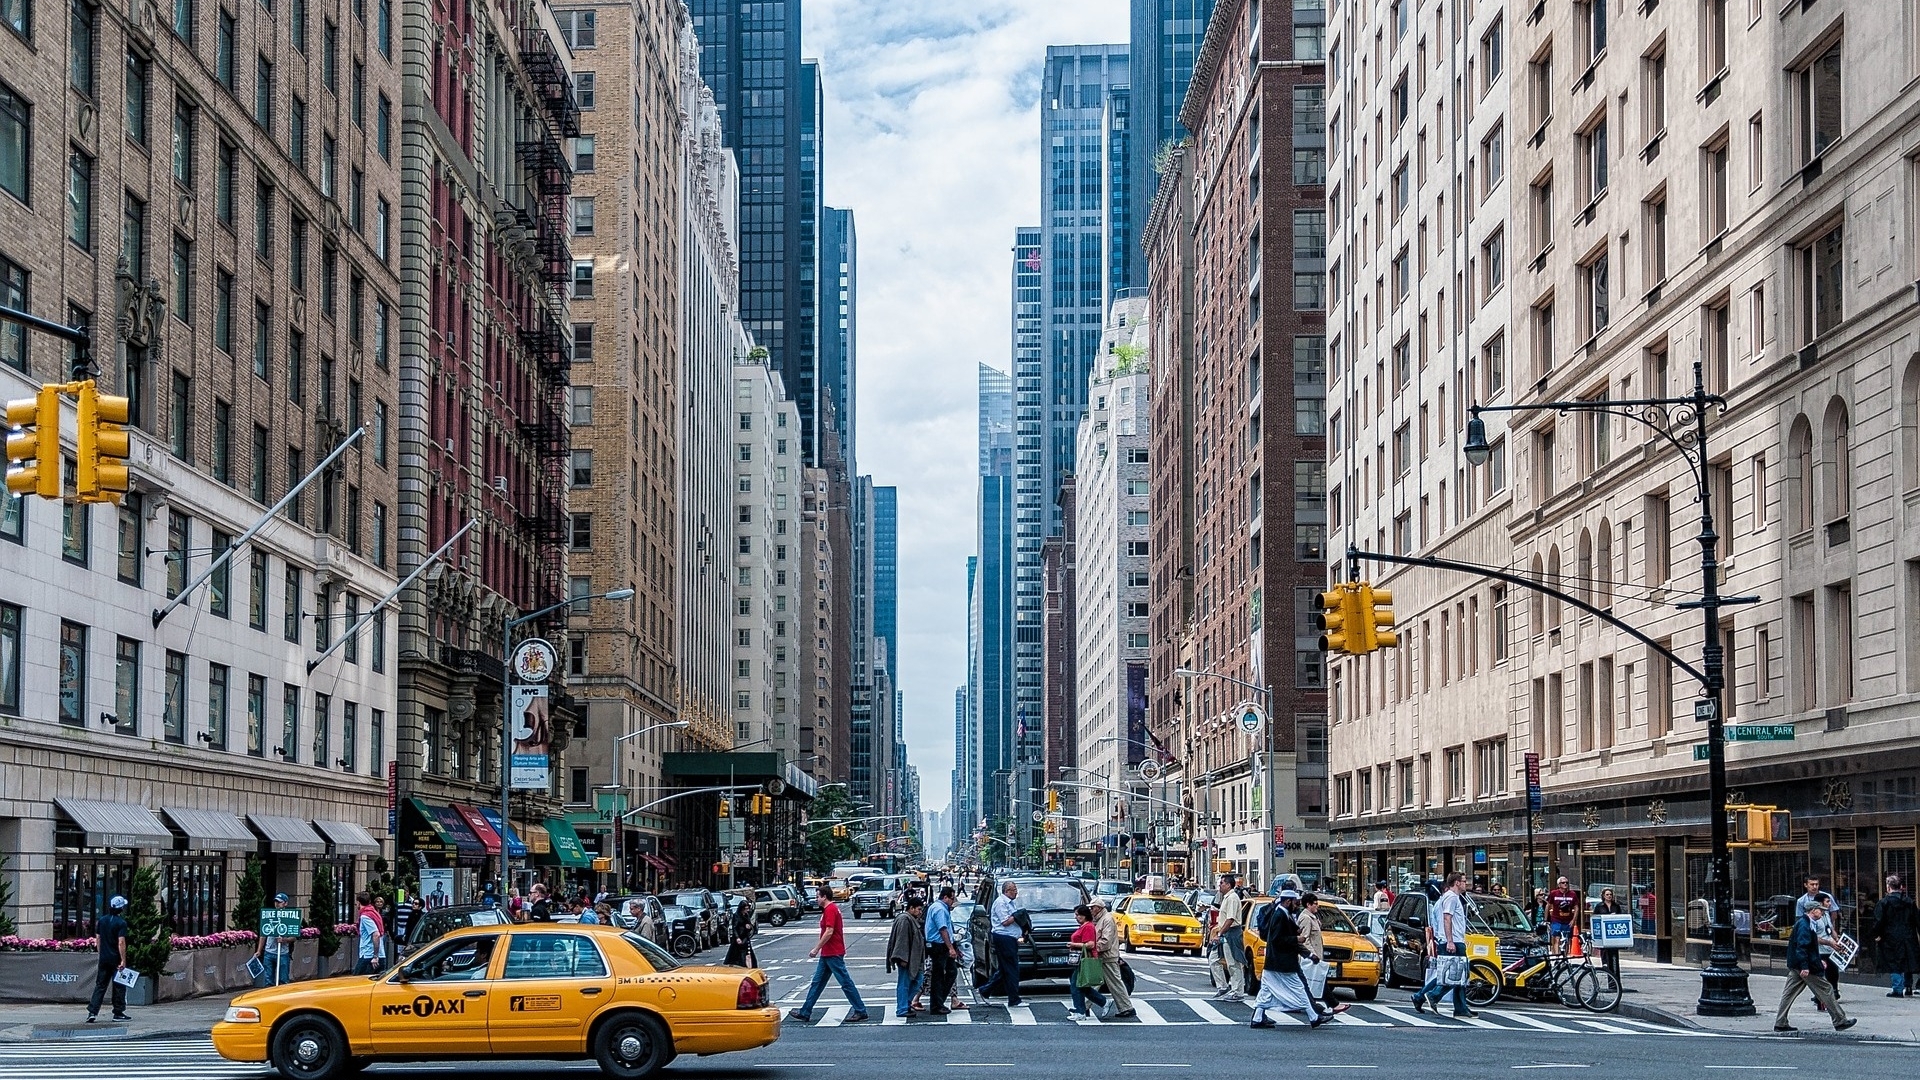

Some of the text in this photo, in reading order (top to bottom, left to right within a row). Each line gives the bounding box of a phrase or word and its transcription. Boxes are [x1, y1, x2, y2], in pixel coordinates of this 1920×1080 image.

[1737, 726, 1794, 735] CENTRAL PARK
[261, 910, 300, 919] BIKE RENTAL
[41, 973, 79, 982] MARKET
[382, 996, 465, 1017] NYC TAXI
